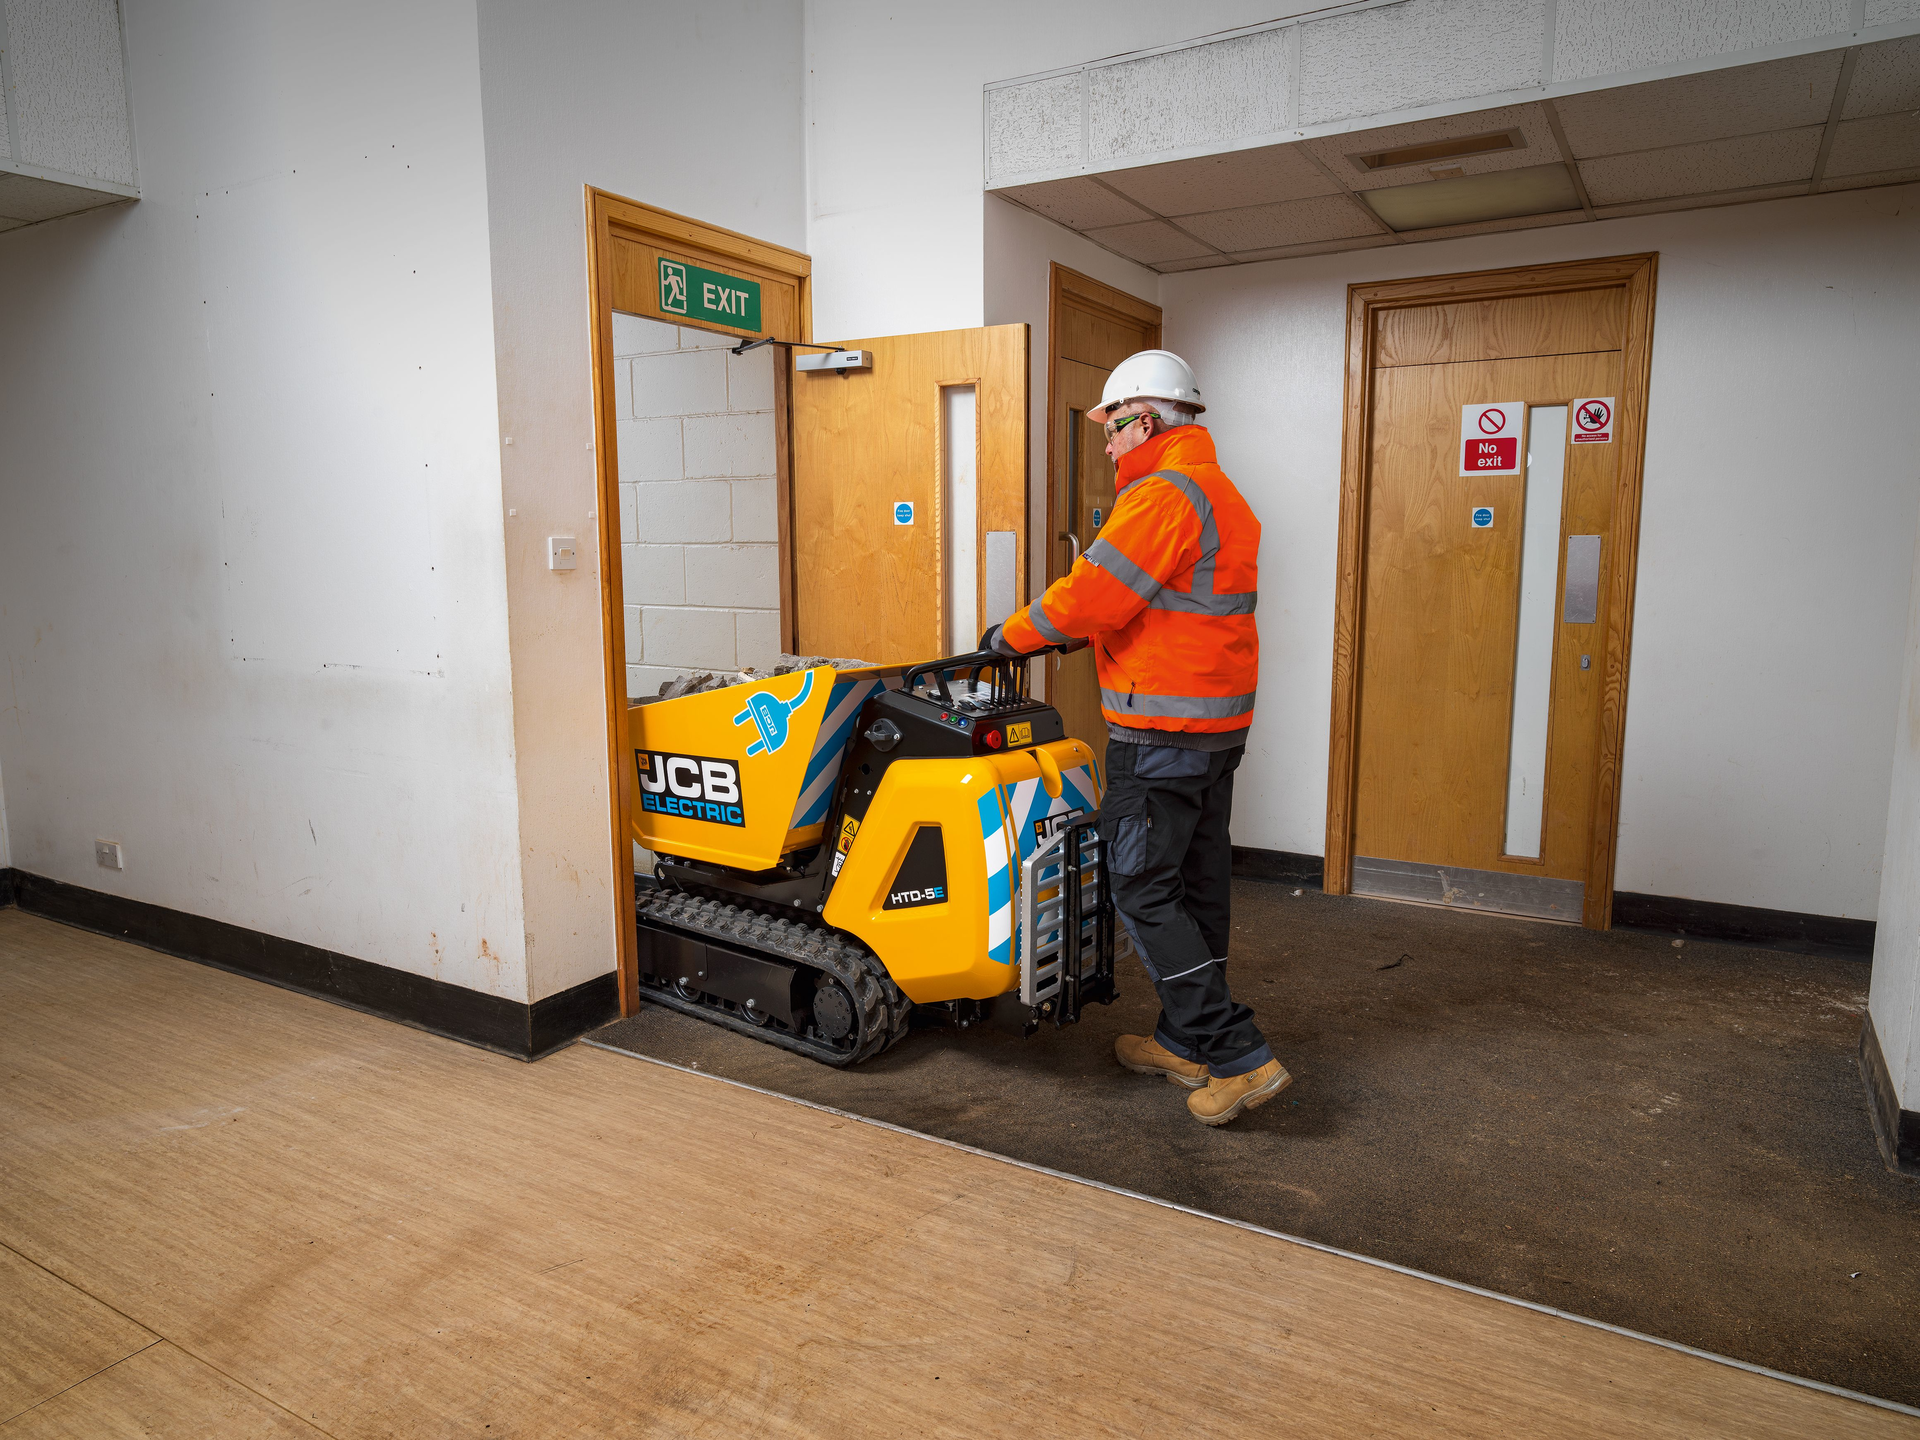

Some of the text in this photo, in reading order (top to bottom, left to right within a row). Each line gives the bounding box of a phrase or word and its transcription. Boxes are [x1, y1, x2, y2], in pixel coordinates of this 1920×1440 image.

[703, 282, 749, 317] EXIT
[1478, 442, 1497, 454] No
[1477, 455, 1502, 467] exit
[640, 755, 739, 804] JCB
[642, 793, 743, 824] ELECTRIC
[891, 886, 945, 905] HTD-5E
